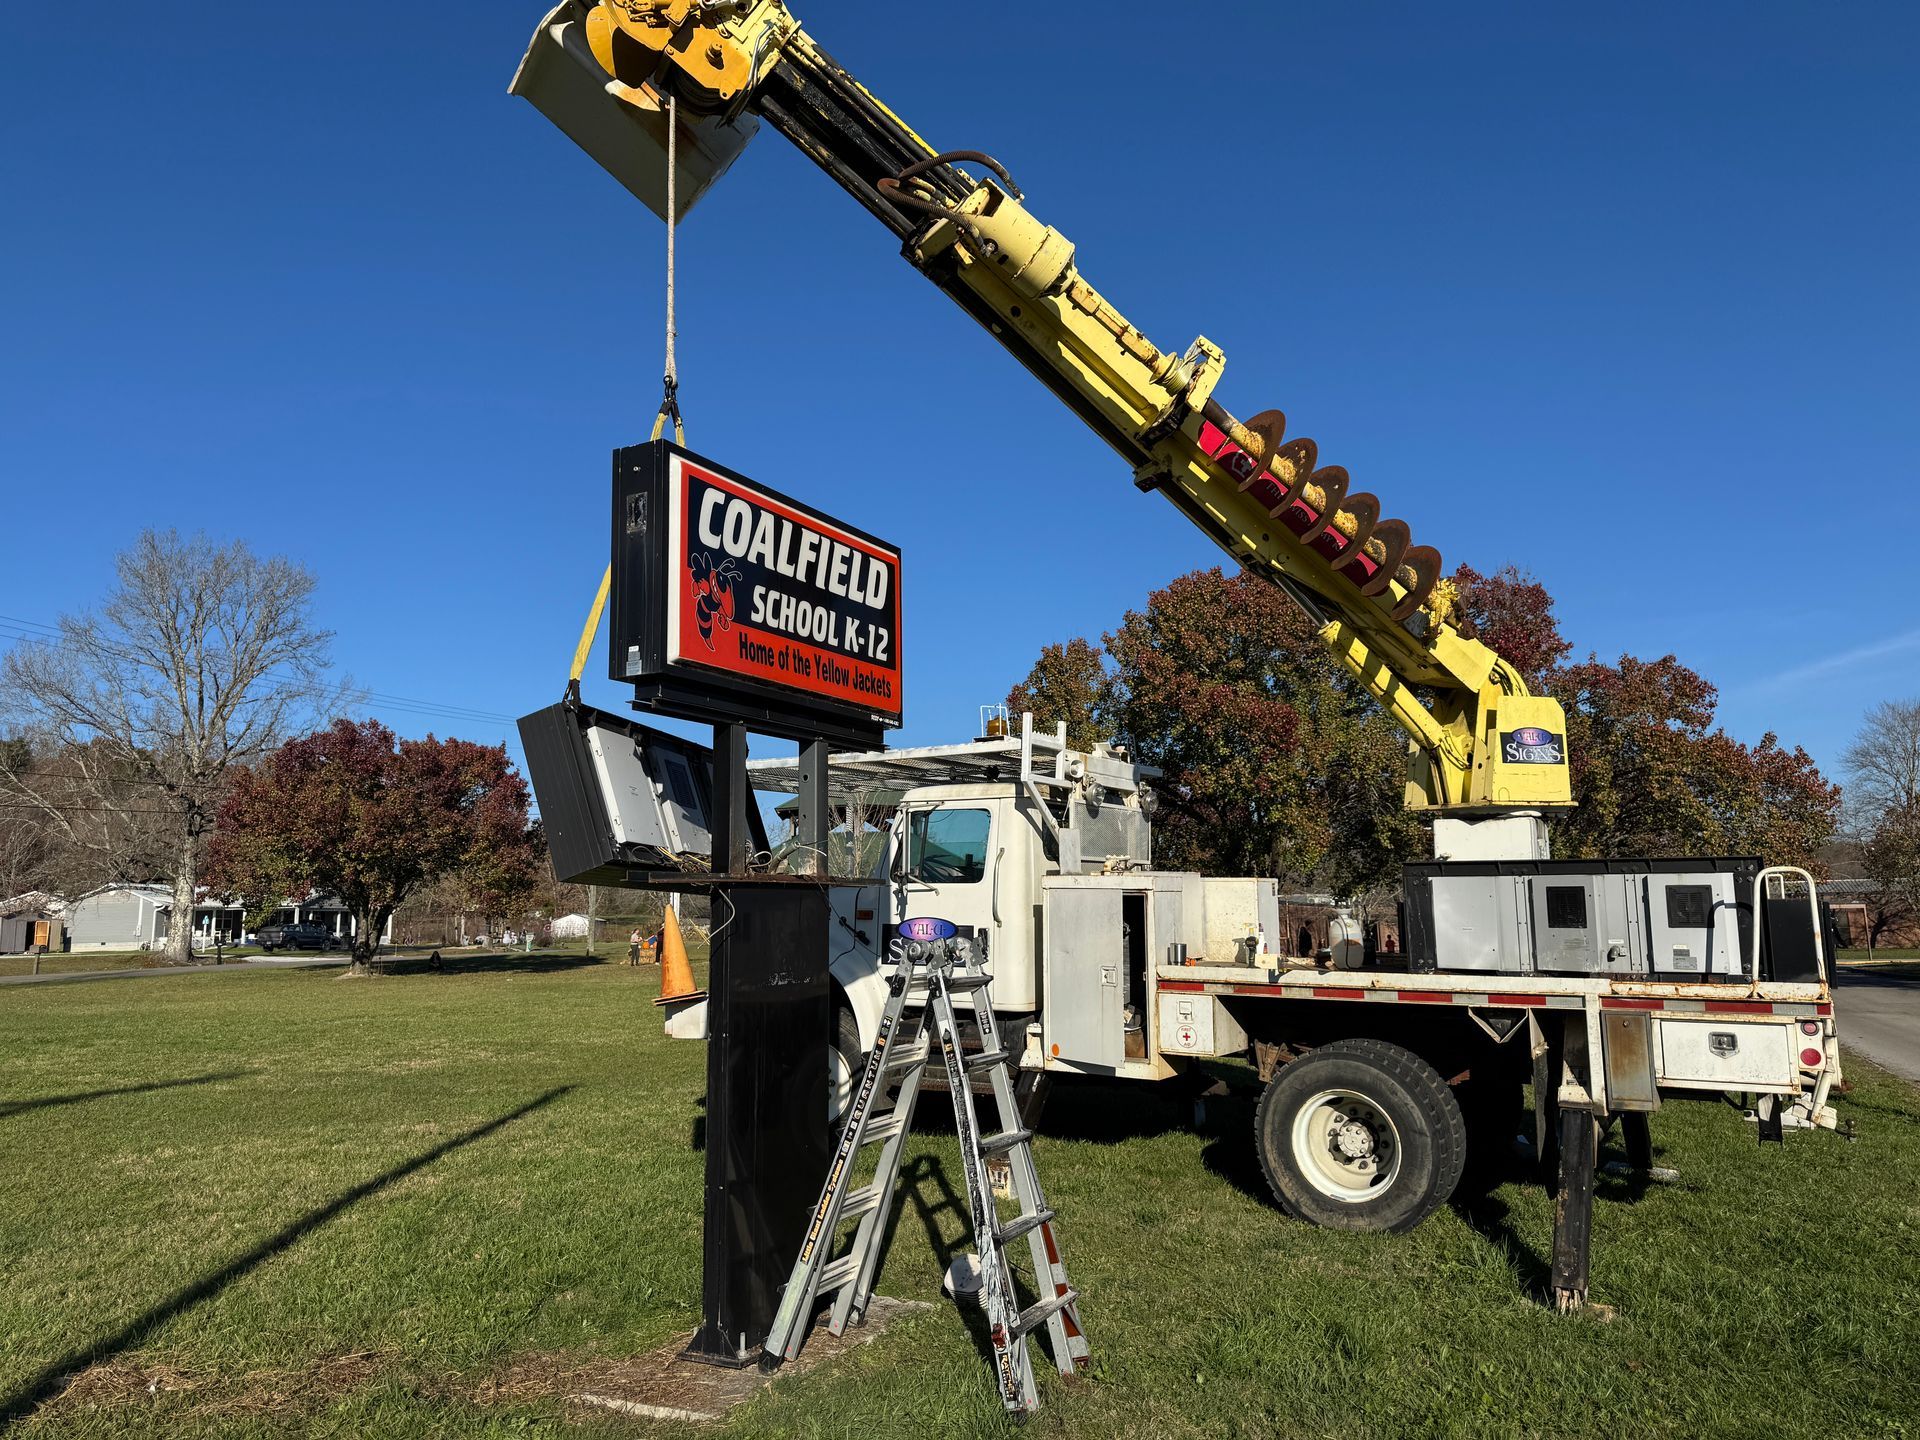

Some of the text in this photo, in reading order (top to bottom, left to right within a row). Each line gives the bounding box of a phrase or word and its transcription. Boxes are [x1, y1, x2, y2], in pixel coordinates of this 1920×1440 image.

[698, 487, 888, 610] COALFIELD
[751, 584, 889, 662] SCHOOL K-12
[738, 632, 892, 698] Home of the Yellow Jackets
[853, 1049, 882, 1120] QUANTUM
